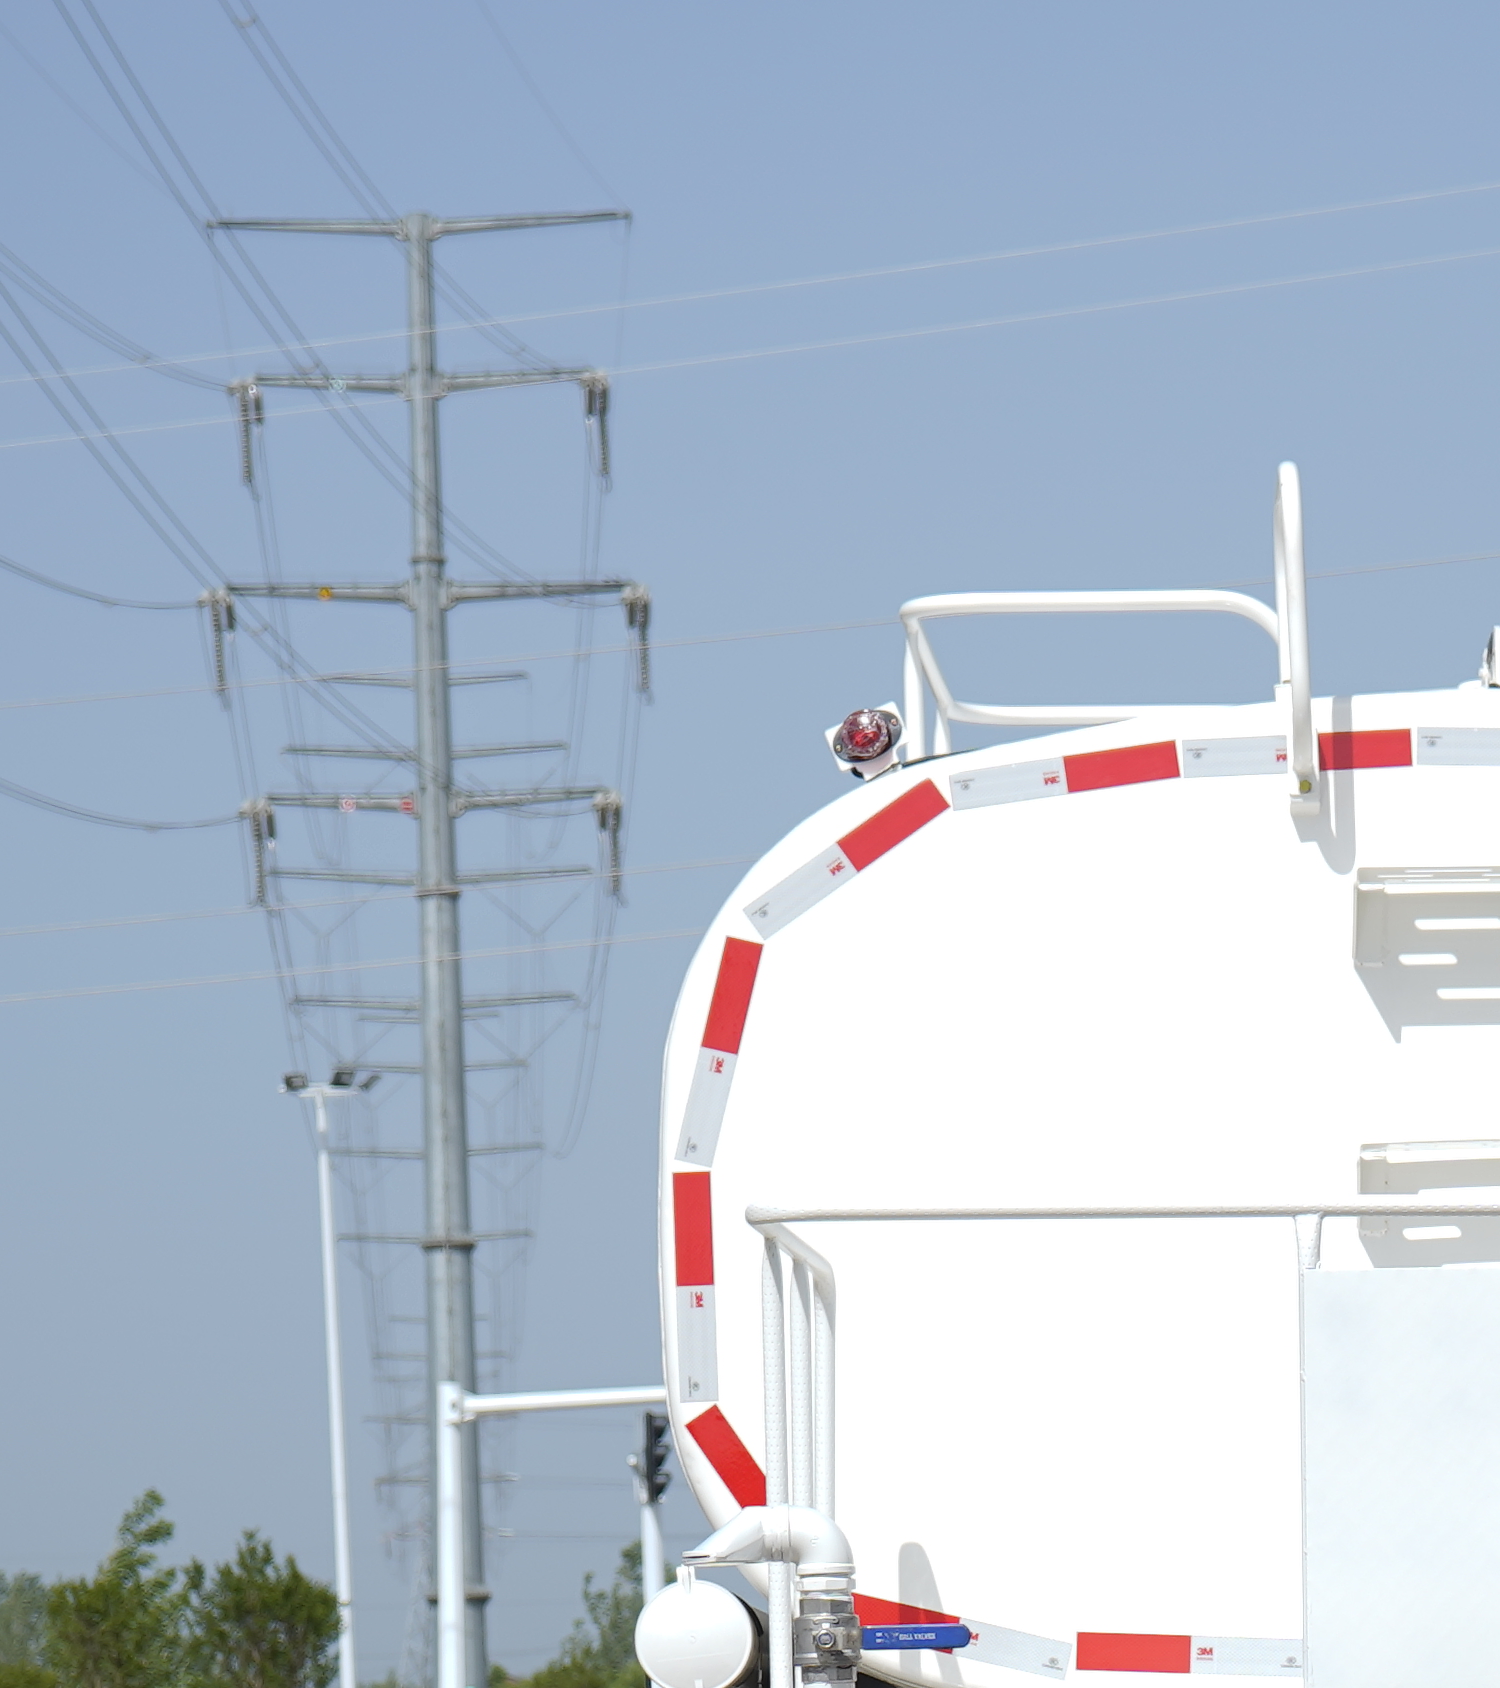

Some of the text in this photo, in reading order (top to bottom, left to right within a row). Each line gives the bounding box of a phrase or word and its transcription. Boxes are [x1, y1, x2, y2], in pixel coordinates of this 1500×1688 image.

[1043, 775, 1060, 786] 3M
[829, 862, 846, 876] 3M
[715, 1056, 725, 1074] 3M
[695, 1291, 704, 1308] 3M
[1197, 1647, 1214, 1656] 3M
